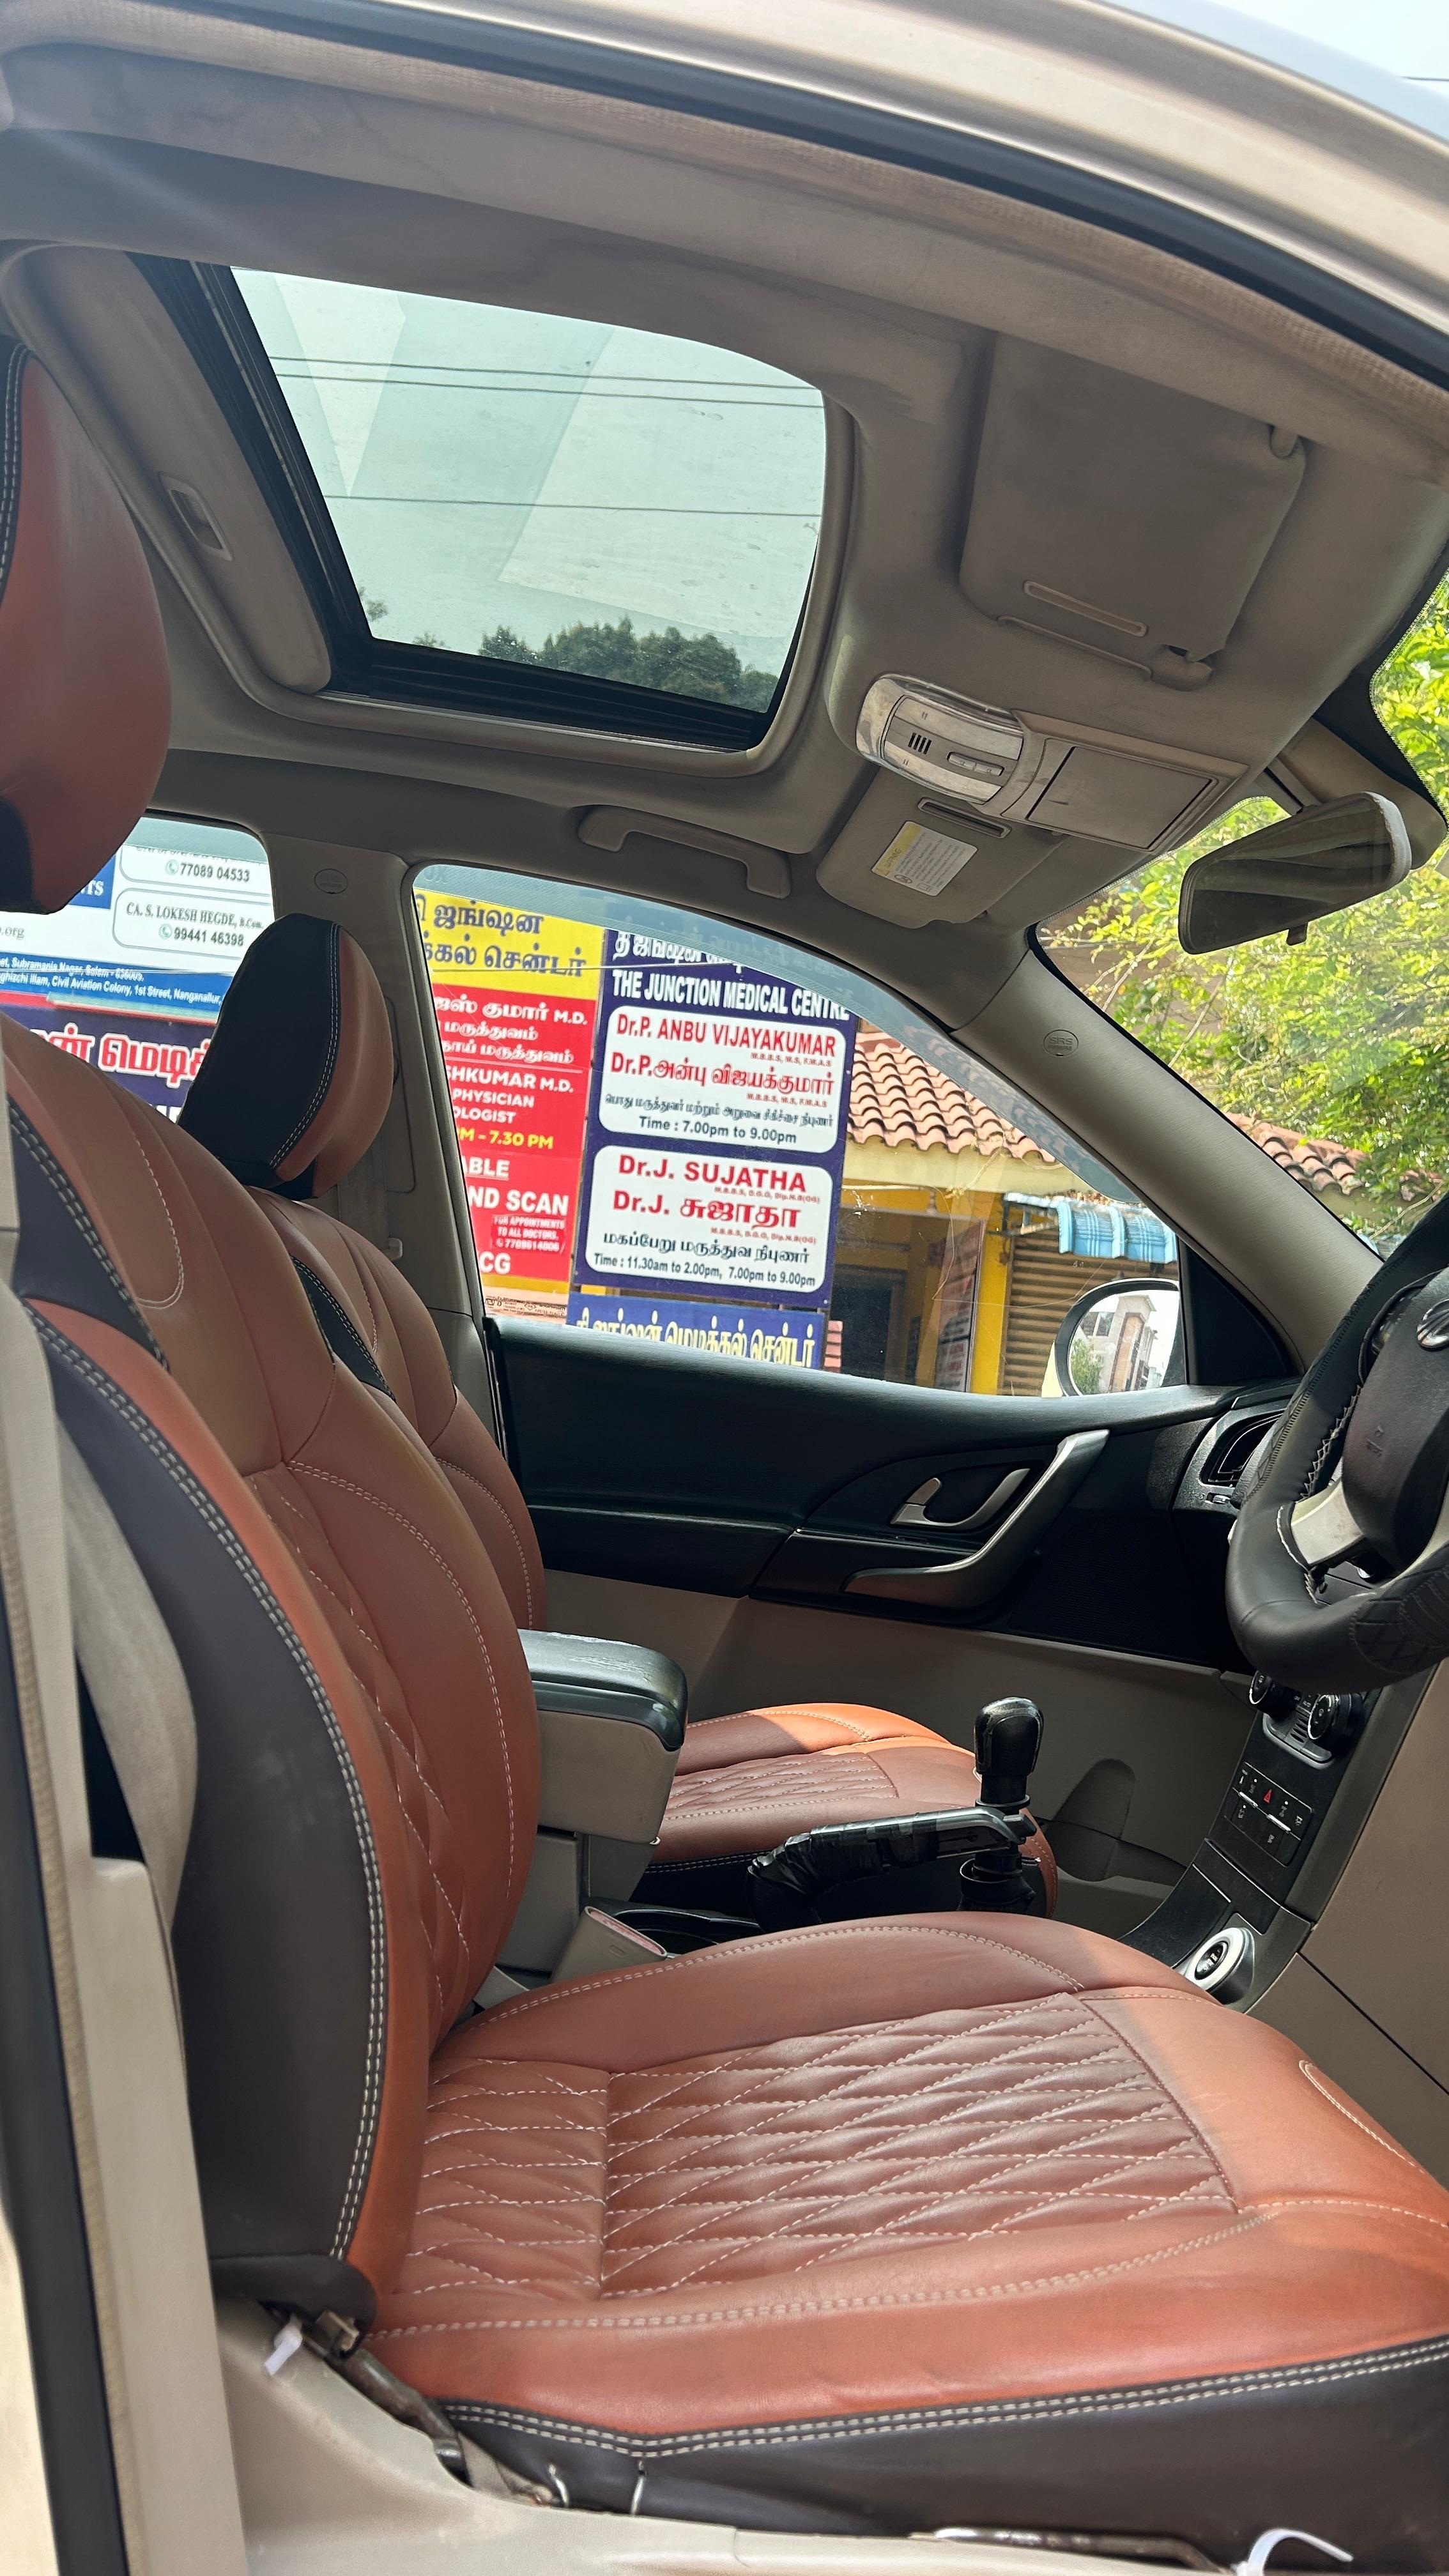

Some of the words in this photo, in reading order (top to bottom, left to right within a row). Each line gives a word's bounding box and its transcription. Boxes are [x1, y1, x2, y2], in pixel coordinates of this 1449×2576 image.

[180, 862, 213, 878] 77089
[217, 867, 250, 882] 04533
[156, 905, 198, 923] LOKESH
[173, 926, 207, 943] 99441
[210, 930, 245, 947] 46398
[51, 975, 70, 988] Civil
[70, 977, 102, 992] Aviation
[134, 984, 146, 997] 1st
[613, 969, 643, 999] THE
[644, 973, 722, 1008] JUNCTION
[723, 981, 788, 1015] MEDICAL
[553, 1009, 588, 1026] M.D.
[657, 1017, 707, 1043] ANBU
[712, 1023, 836, 1057] VIJAYAKUMAR
[539, 1077, 574, 1093] M.D.
[711, 1062, 834, 1095] விஜயக்குமார்
[452, 1087, 535, 1108] PHYSICIAN
[489, 1129, 525, 1147] 7.30
[527, 1133, 555, 1151] PM
[639, 1116, 670, 1130] Time
[682, 1120, 728, 1138] 7.00pm
[733, 1126, 746, 1138] to
[750, 1127, 797, 1145] 9.00pm
[684, 1160, 806, 1193] SUJATHA
[505, 1188, 569, 1216] SCAN
[680, 1197, 802, 1230] சுஜாதா
[594, 1252, 618, 1267] Time
[627, 1255, 668, 1273] 11.30am
[671, 1261, 681, 1273] to
[728, 1266, 764, 1284] 7.00pm
[767, 1270, 777, 1283] to
[779, 1271, 816, 1288] 9.00pm
